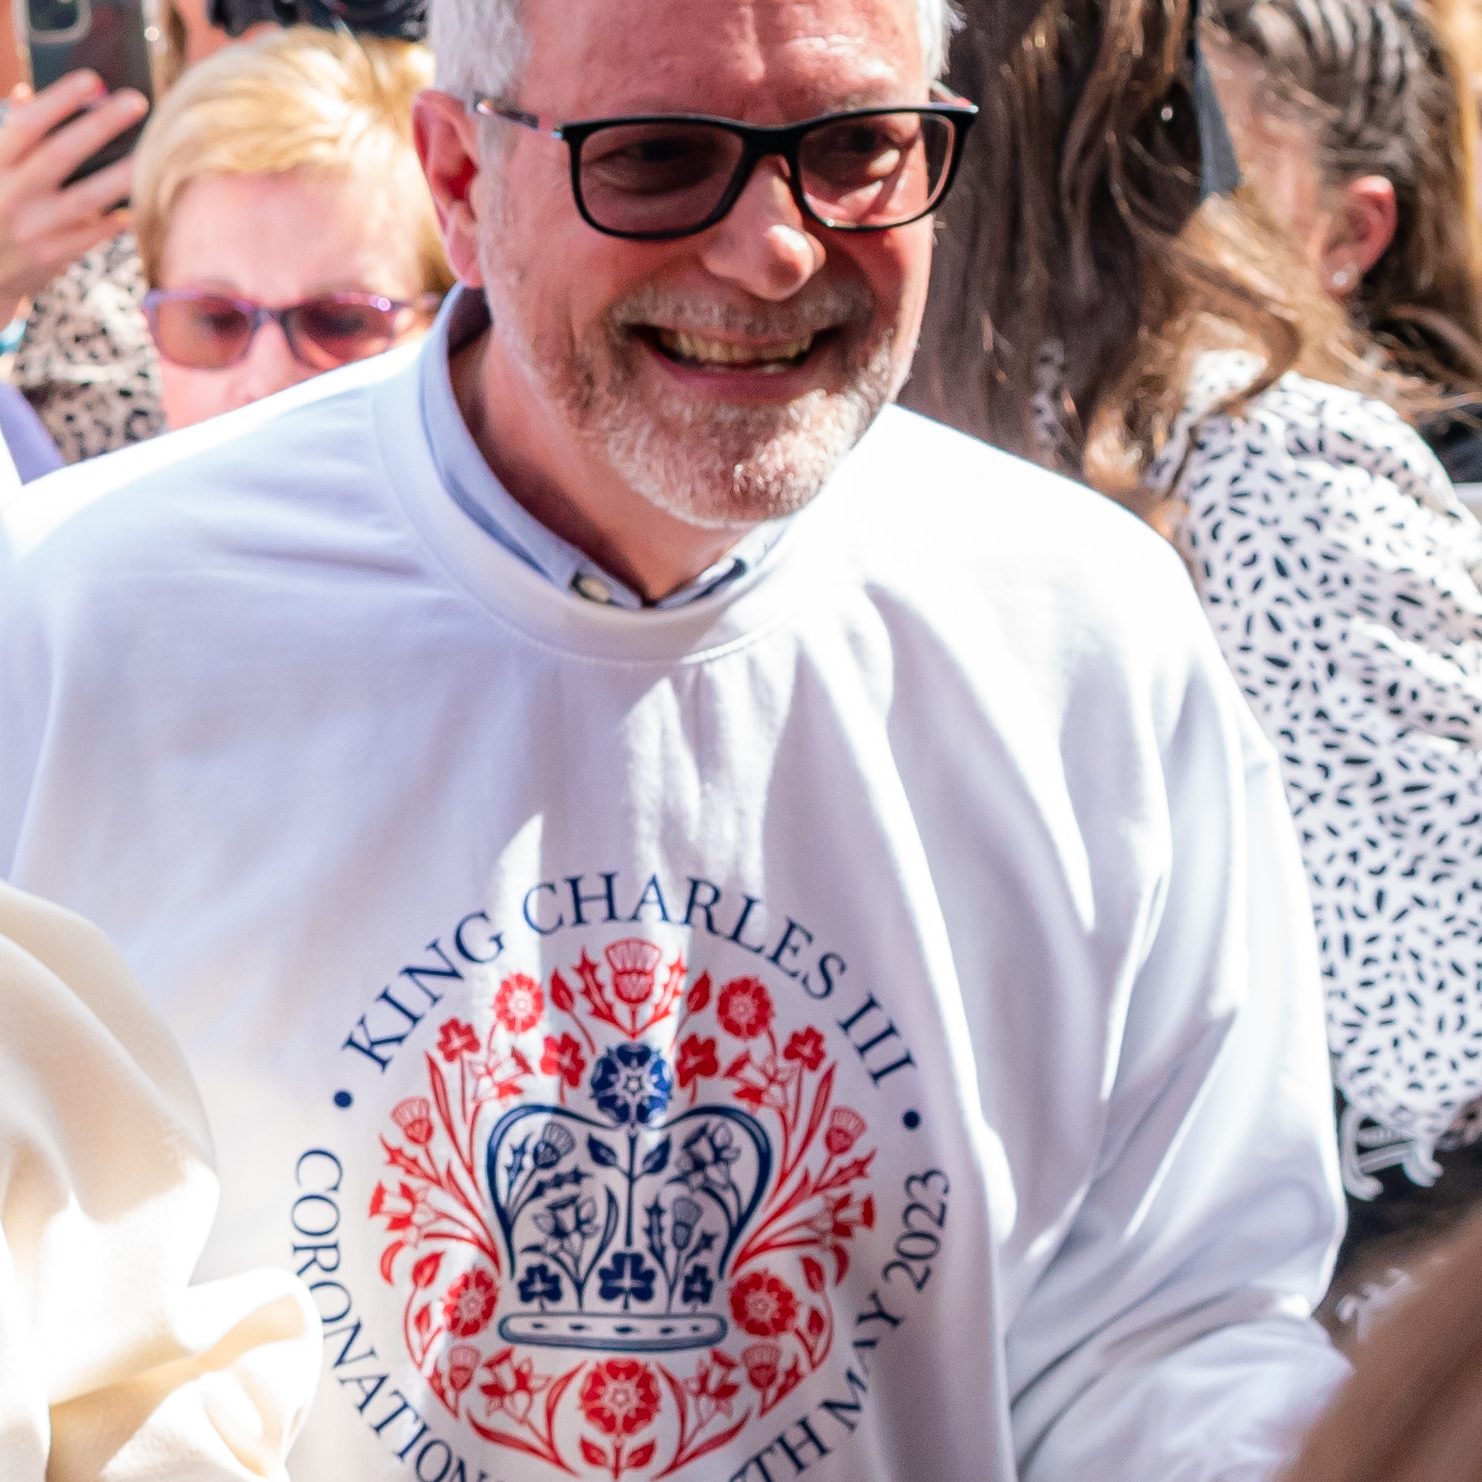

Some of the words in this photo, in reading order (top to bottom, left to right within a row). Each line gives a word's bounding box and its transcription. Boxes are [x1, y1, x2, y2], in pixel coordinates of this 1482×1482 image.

[341, 910, 504, 1073] KING
[521, 872, 848, 1001] CHARLES
[835, 991, 918, 1089] III
[821, 1291, 905, 1433] MAY
[882, 1168, 952, 1293] 2023
